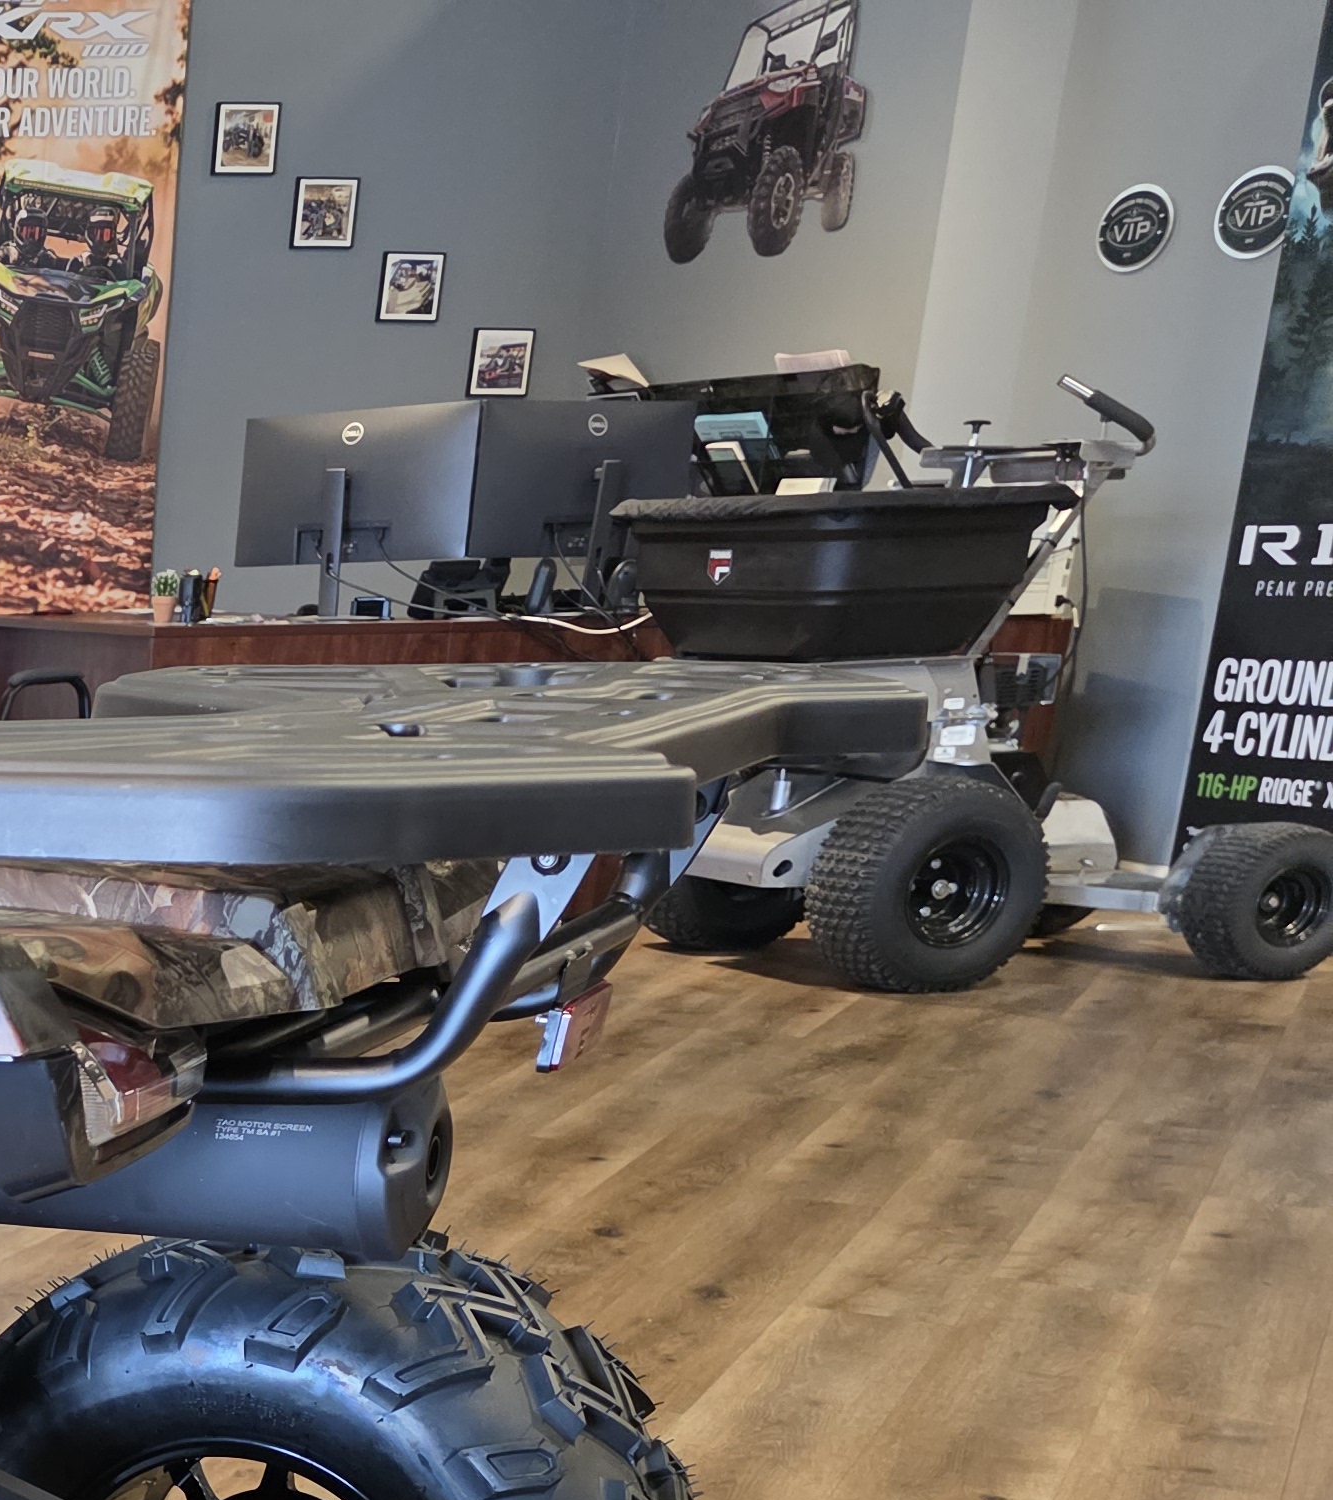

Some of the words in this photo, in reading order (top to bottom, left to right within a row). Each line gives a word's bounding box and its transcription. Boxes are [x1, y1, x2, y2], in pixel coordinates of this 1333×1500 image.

[82, 43, 150, 58] 1000
[47, 67, 136, 99] WORLD.
[18, 106, 157, 138] ADVENTURE.
[1234, 204, 1276, 228] VIP
[1113, 219, 1151, 243] VIP
[1254, 580, 1296, 598] PEAK
[1196, 771, 1258, 802] 116-HP
[216, 1126, 239, 1134] TYPE
[241, 1127, 254, 1135] TM
[217, 1119, 236, 1127] TAO
[238, 1120, 272, 1130] MOTOR
[273, 1123, 313, 1132] SCREEN
